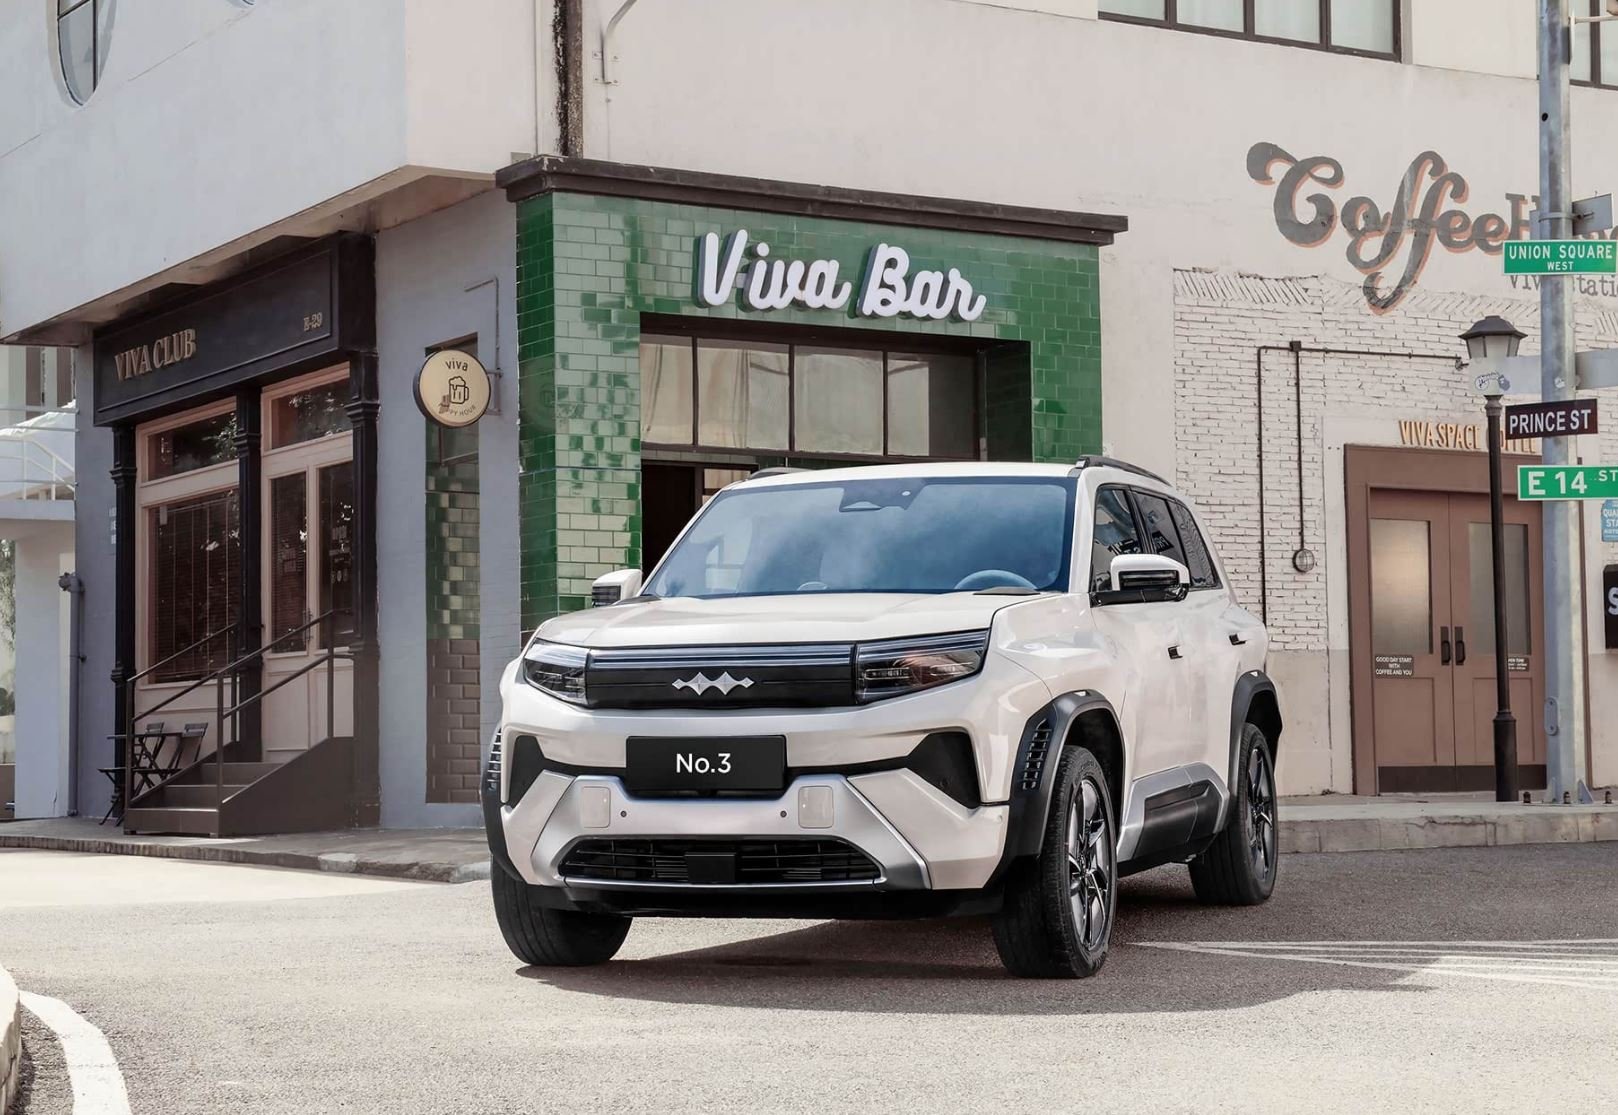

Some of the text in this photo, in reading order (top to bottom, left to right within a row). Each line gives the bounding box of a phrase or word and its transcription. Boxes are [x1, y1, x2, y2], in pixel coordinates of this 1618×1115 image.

[1509, 244, 1613, 260] UNION SQUARE
[700, 229, 987, 321] Viva Bar
[1547, 261, 1574, 271] WEST
[1572, 274, 1618, 297] tati
[114, 328, 196, 382] VIVA CLUB
[445, 357, 469, 372] viva
[1398, 420, 1433, 447] VIVA
[1509, 409, 1591, 435] PRINCE ST
[1528, 469, 1618, 496] E 14 ST
[1602, 508, 1618, 518] QUA
[676, 752, 732, 774] No.3
